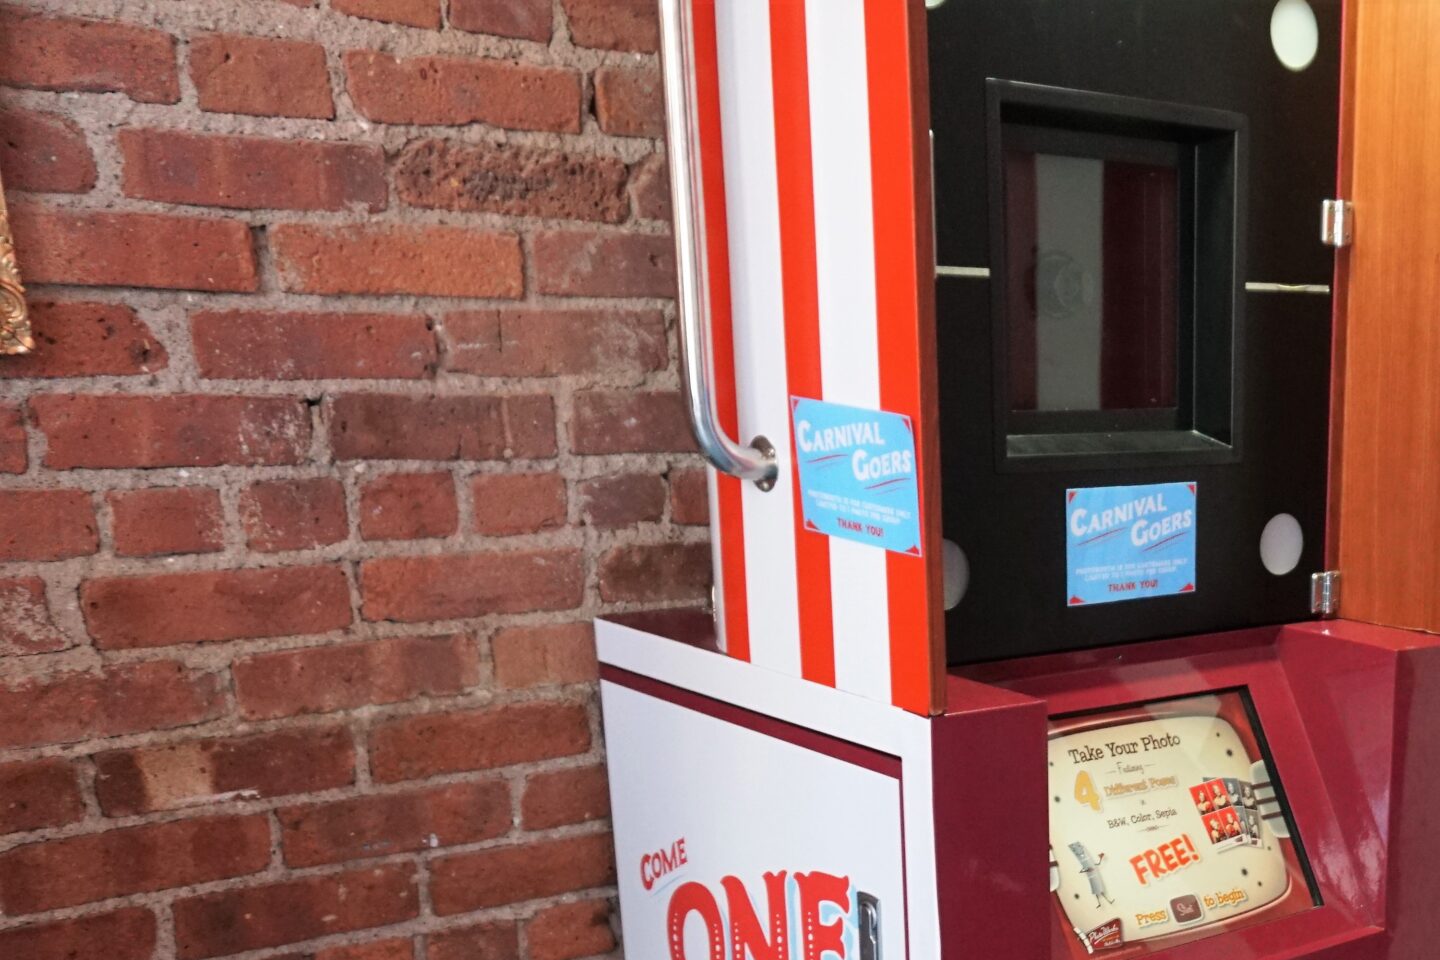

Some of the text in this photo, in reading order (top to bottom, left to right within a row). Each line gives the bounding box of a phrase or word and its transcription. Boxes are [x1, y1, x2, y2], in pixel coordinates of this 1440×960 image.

[797, 420, 886, 452] CARNIVAL
[852, 449, 912, 481] GOERS
[837, 517, 863, 533] THANK
[1070, 493, 1168, 537] CARNIVAL
[1130, 509, 1193, 546] GOERS
[1108, 583, 1136, 593] THANK
[1068, 732, 1181, 764] Take Your Photo
[1074, 770, 1101, 811] 4
[1155, 808, 1178, 819] Sepia
[640, 838, 688, 890] COME
[1129, 833, 1200, 885] FREE!
[1135, 909, 1167, 926] Press
[1204, 896, 1215, 907] to
[1217, 889, 1245, 906] begin
